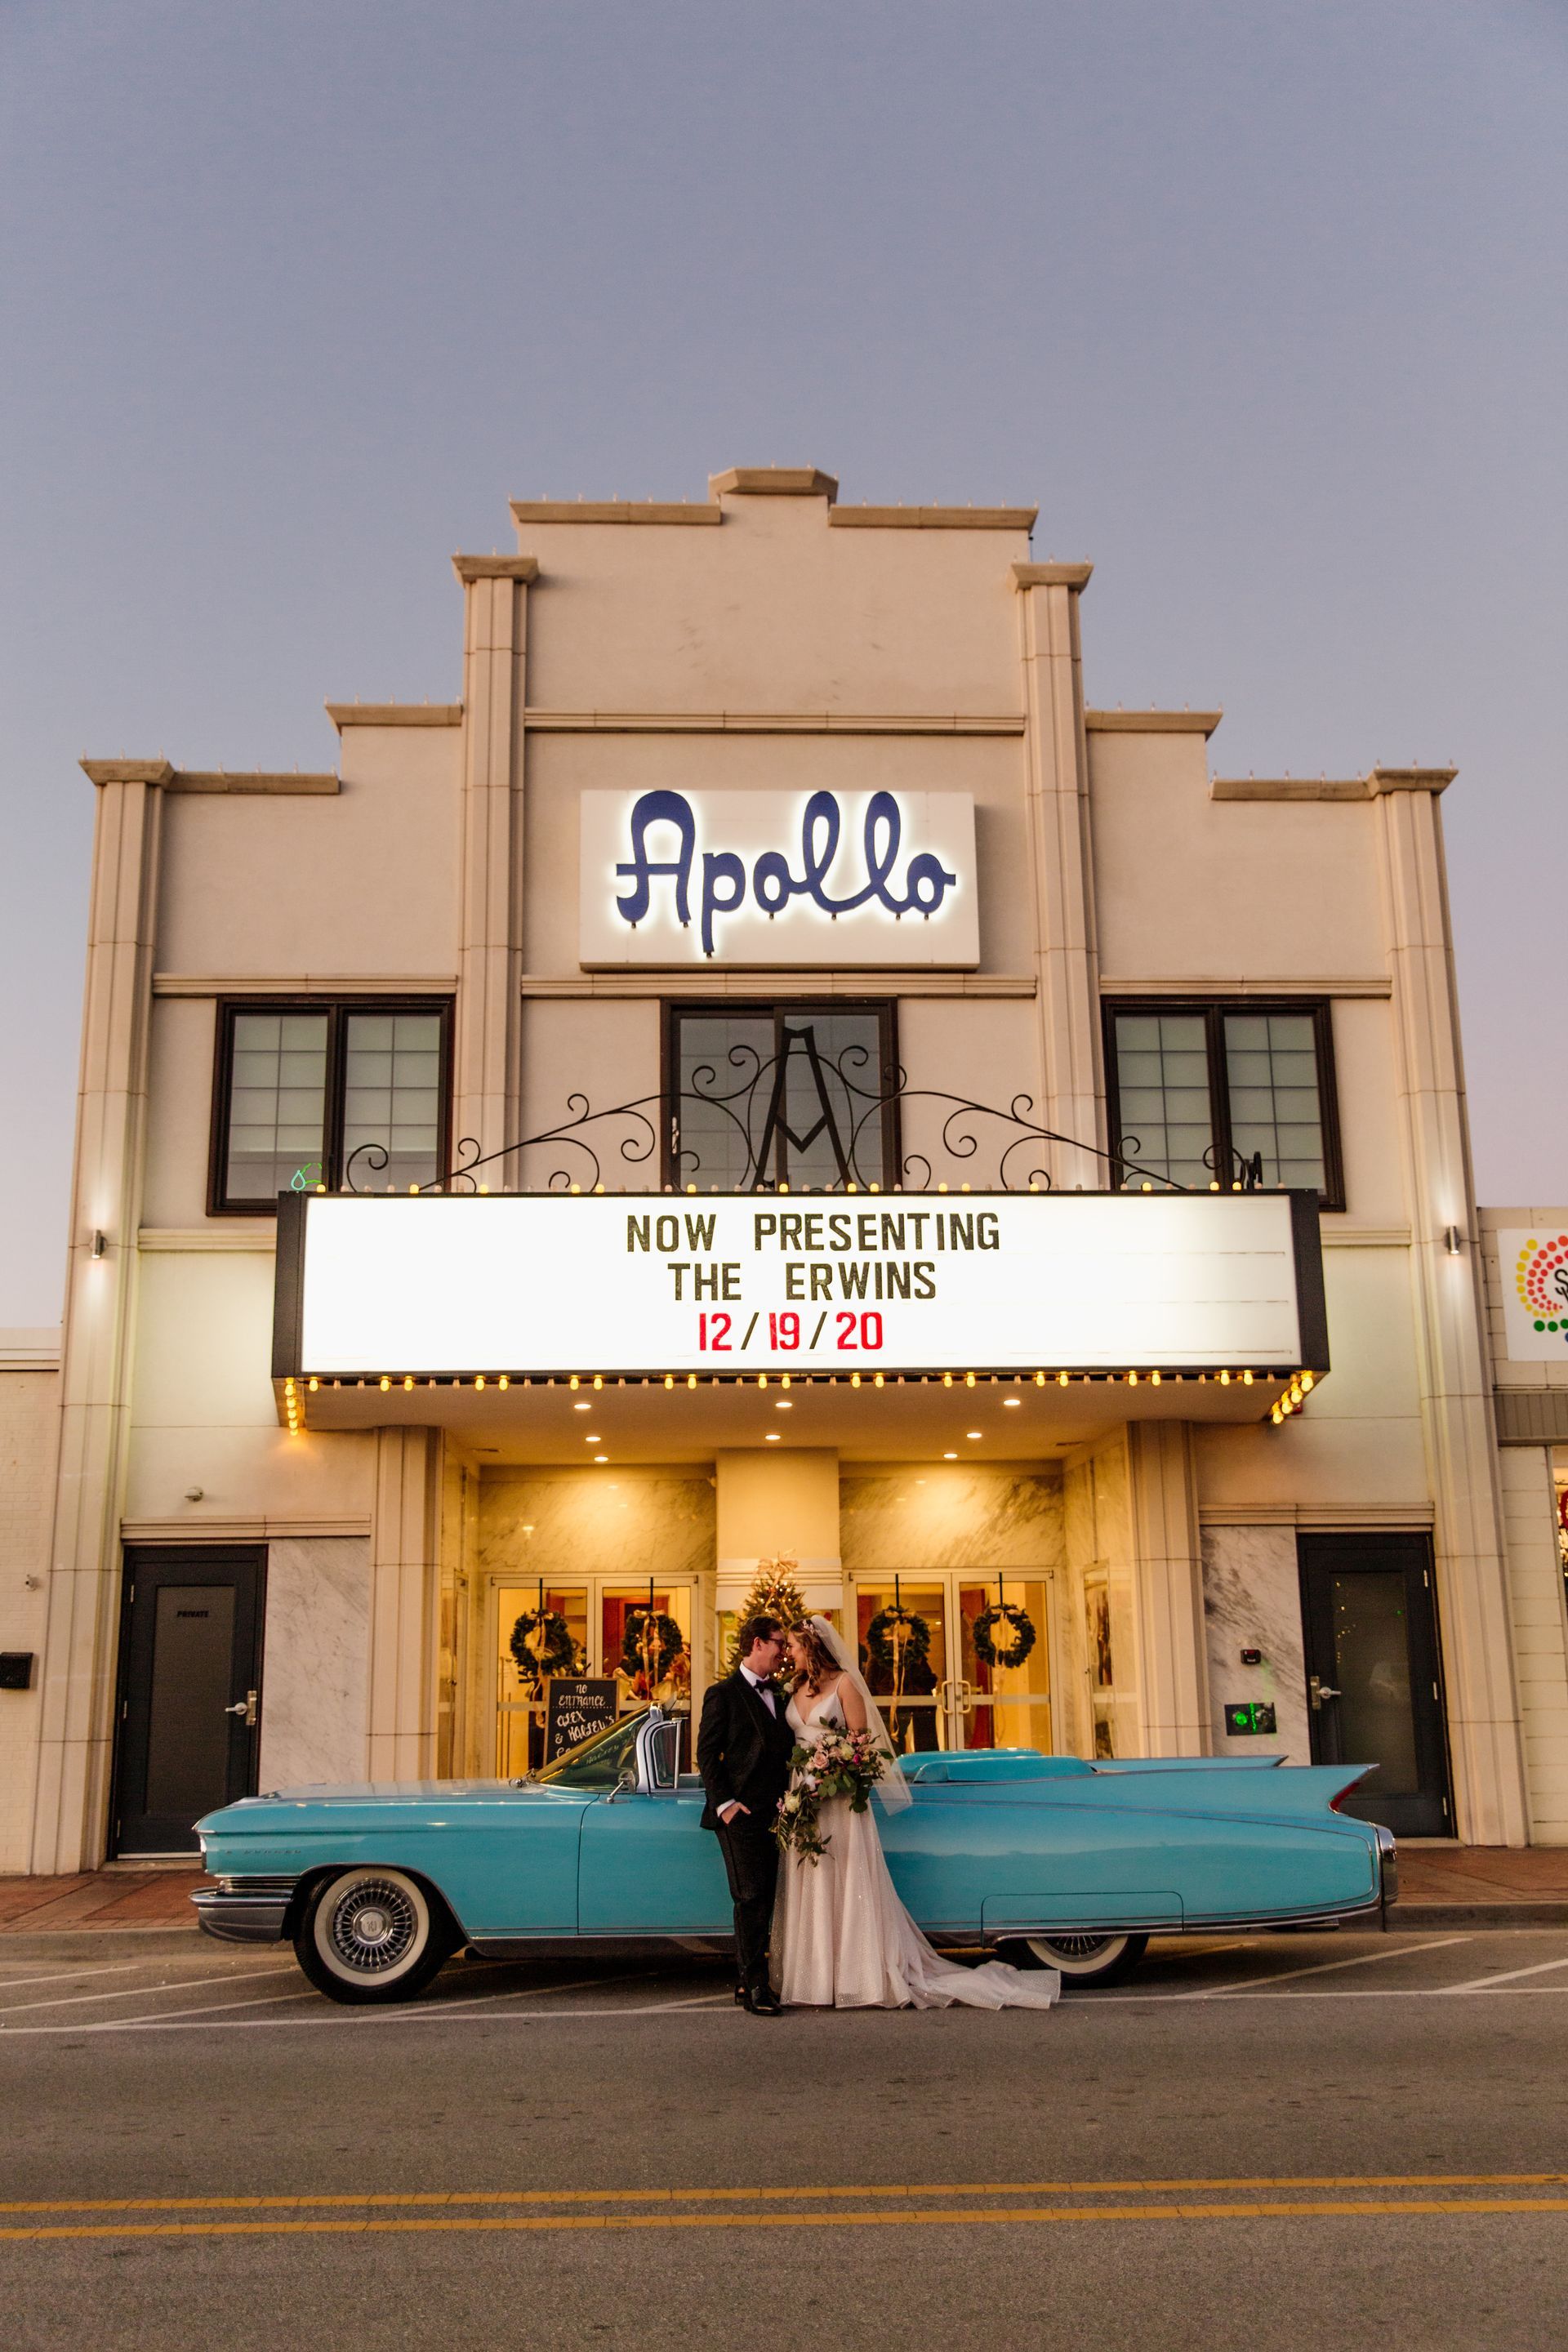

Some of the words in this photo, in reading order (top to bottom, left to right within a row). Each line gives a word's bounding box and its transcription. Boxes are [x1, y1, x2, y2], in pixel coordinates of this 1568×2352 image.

[617, 791, 956, 954] Apollo
[626, 1214, 716, 1252] NOW
[754, 1212, 1000, 1251] PRESENTING
[667, 1263, 742, 1300] THE
[786, 1262, 936, 1300] ERWINS
[555, 1733, 564, 1744] &
